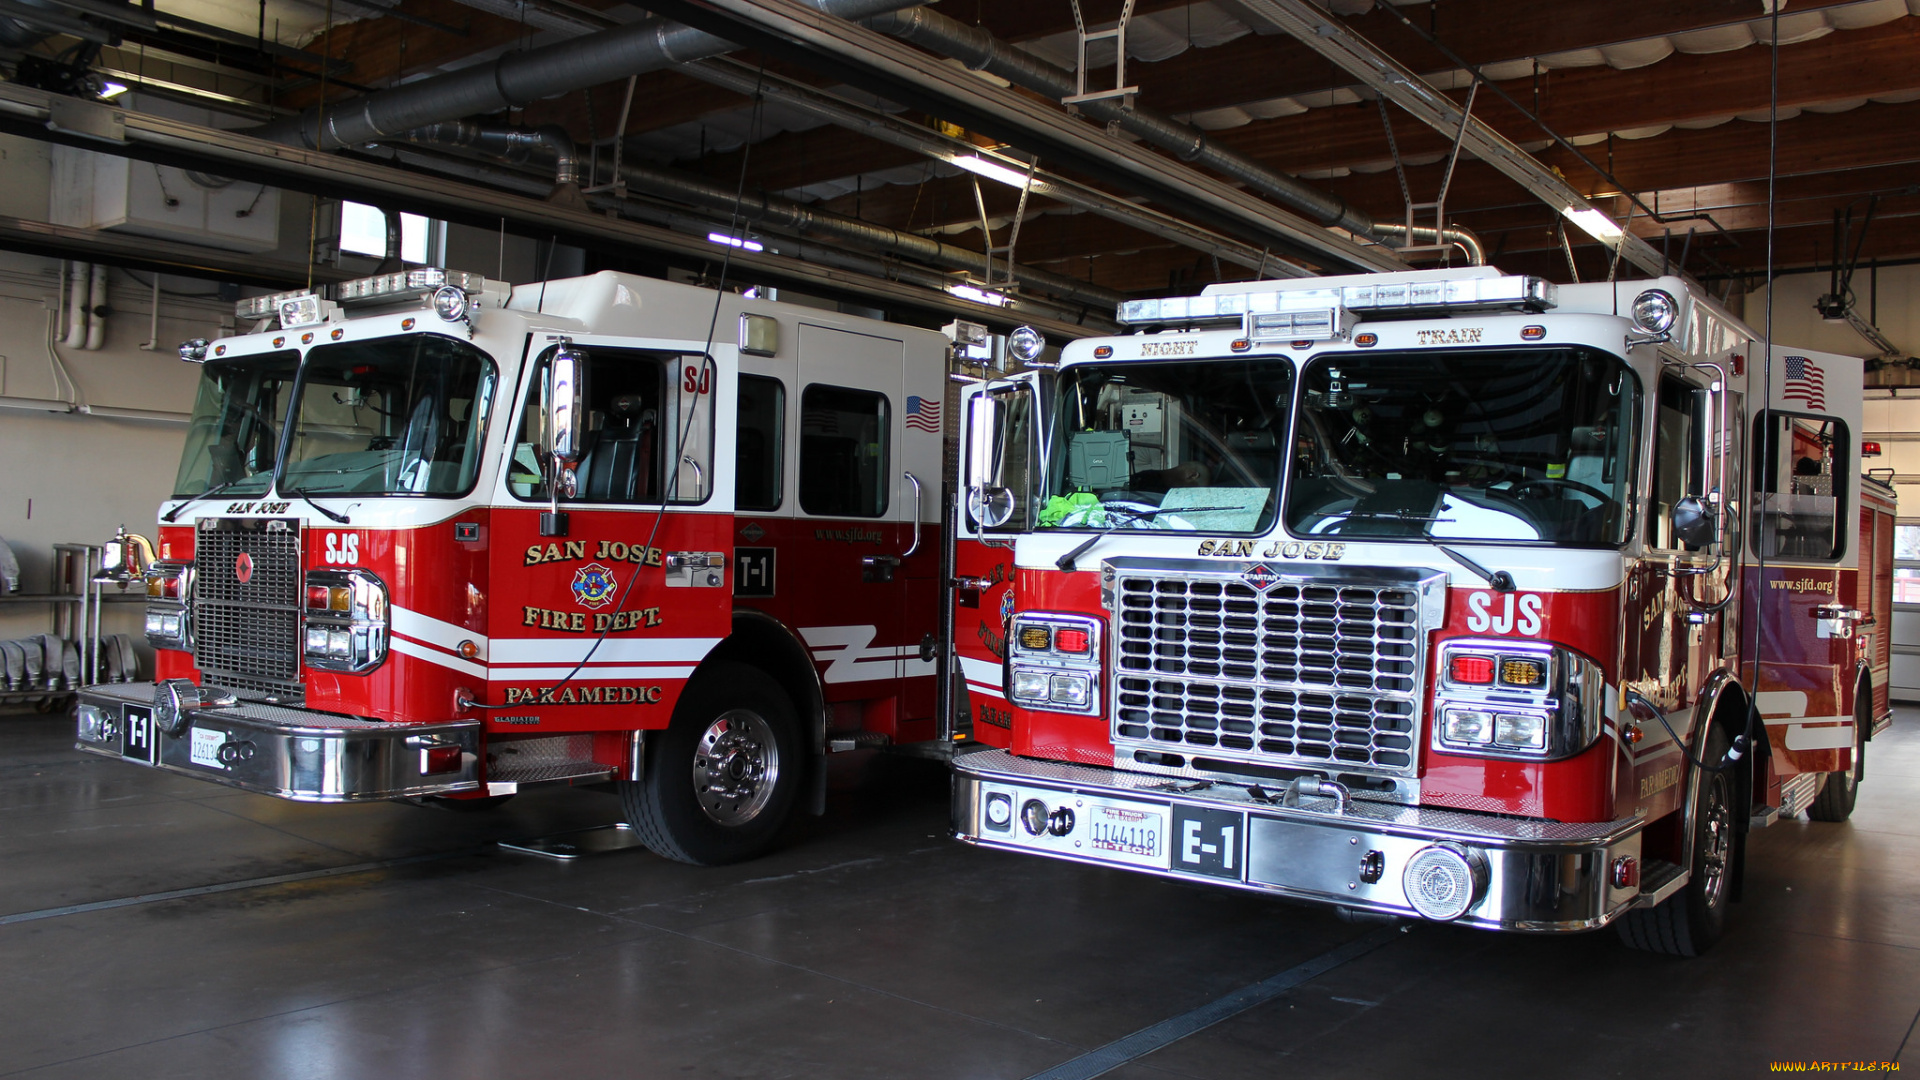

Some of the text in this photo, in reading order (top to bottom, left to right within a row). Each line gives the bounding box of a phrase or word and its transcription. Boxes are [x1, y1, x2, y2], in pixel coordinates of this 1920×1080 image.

[1417, 327, 1484, 345] TRAIN
[1140, 340, 1199, 357] NIGHT
[226, 502, 291, 514] SAN JOSE
[815, 527, 883, 545] www.sjfd.org
[325, 532, 359, 565] SJS
[523, 540, 663, 567] SAN JOSE
[1198, 539, 1346, 560] SAN JOSE
[740, 556, 767, 587] T-1
[1243, 573, 1278, 581] SPARTAN
[1769, 578, 1834, 595] www.sjfd.org
[522, 606, 663, 633] FIRE DEPT.
[1467, 591, 1542, 636] SJS
[1643, 589, 1664, 632] SAN
[504, 686, 662, 705] PARAMEDIC
[129, 714, 147, 748] T-1
[1092, 840, 1154, 856] HI-TECH
[1093, 822, 1156, 850] 1144118
[1182, 819, 1235, 869] E-1
